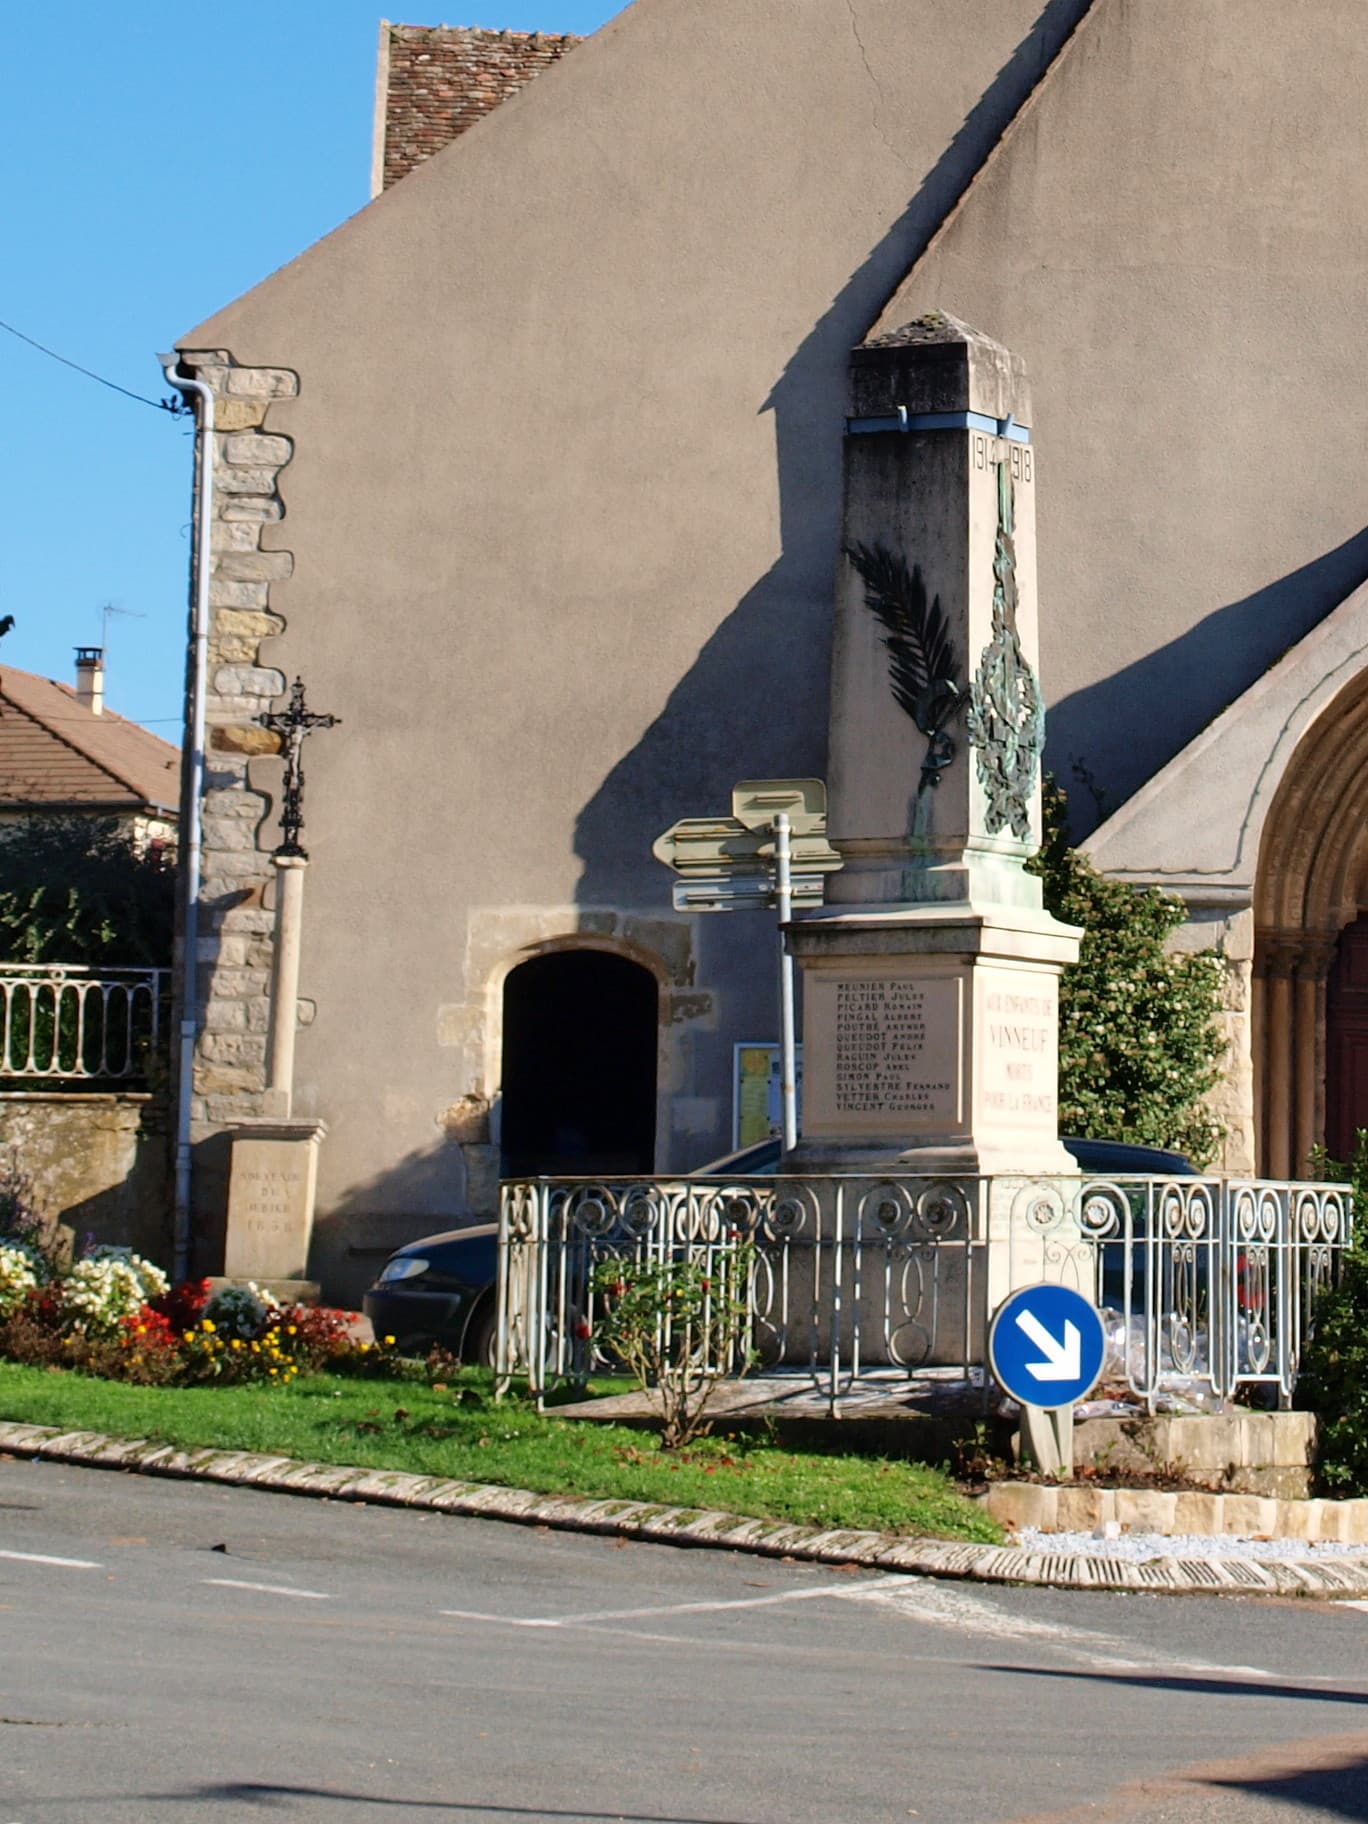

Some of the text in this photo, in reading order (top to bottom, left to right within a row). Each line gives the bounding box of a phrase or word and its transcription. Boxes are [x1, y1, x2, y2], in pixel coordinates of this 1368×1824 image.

[972, 434, 1032, 483] 1914 1918
[836, 1002, 880, 1012] PICARD
[989, 1024, 1049, 1053] VINNEUF
[836, 1102, 885, 1112] VINCENT
